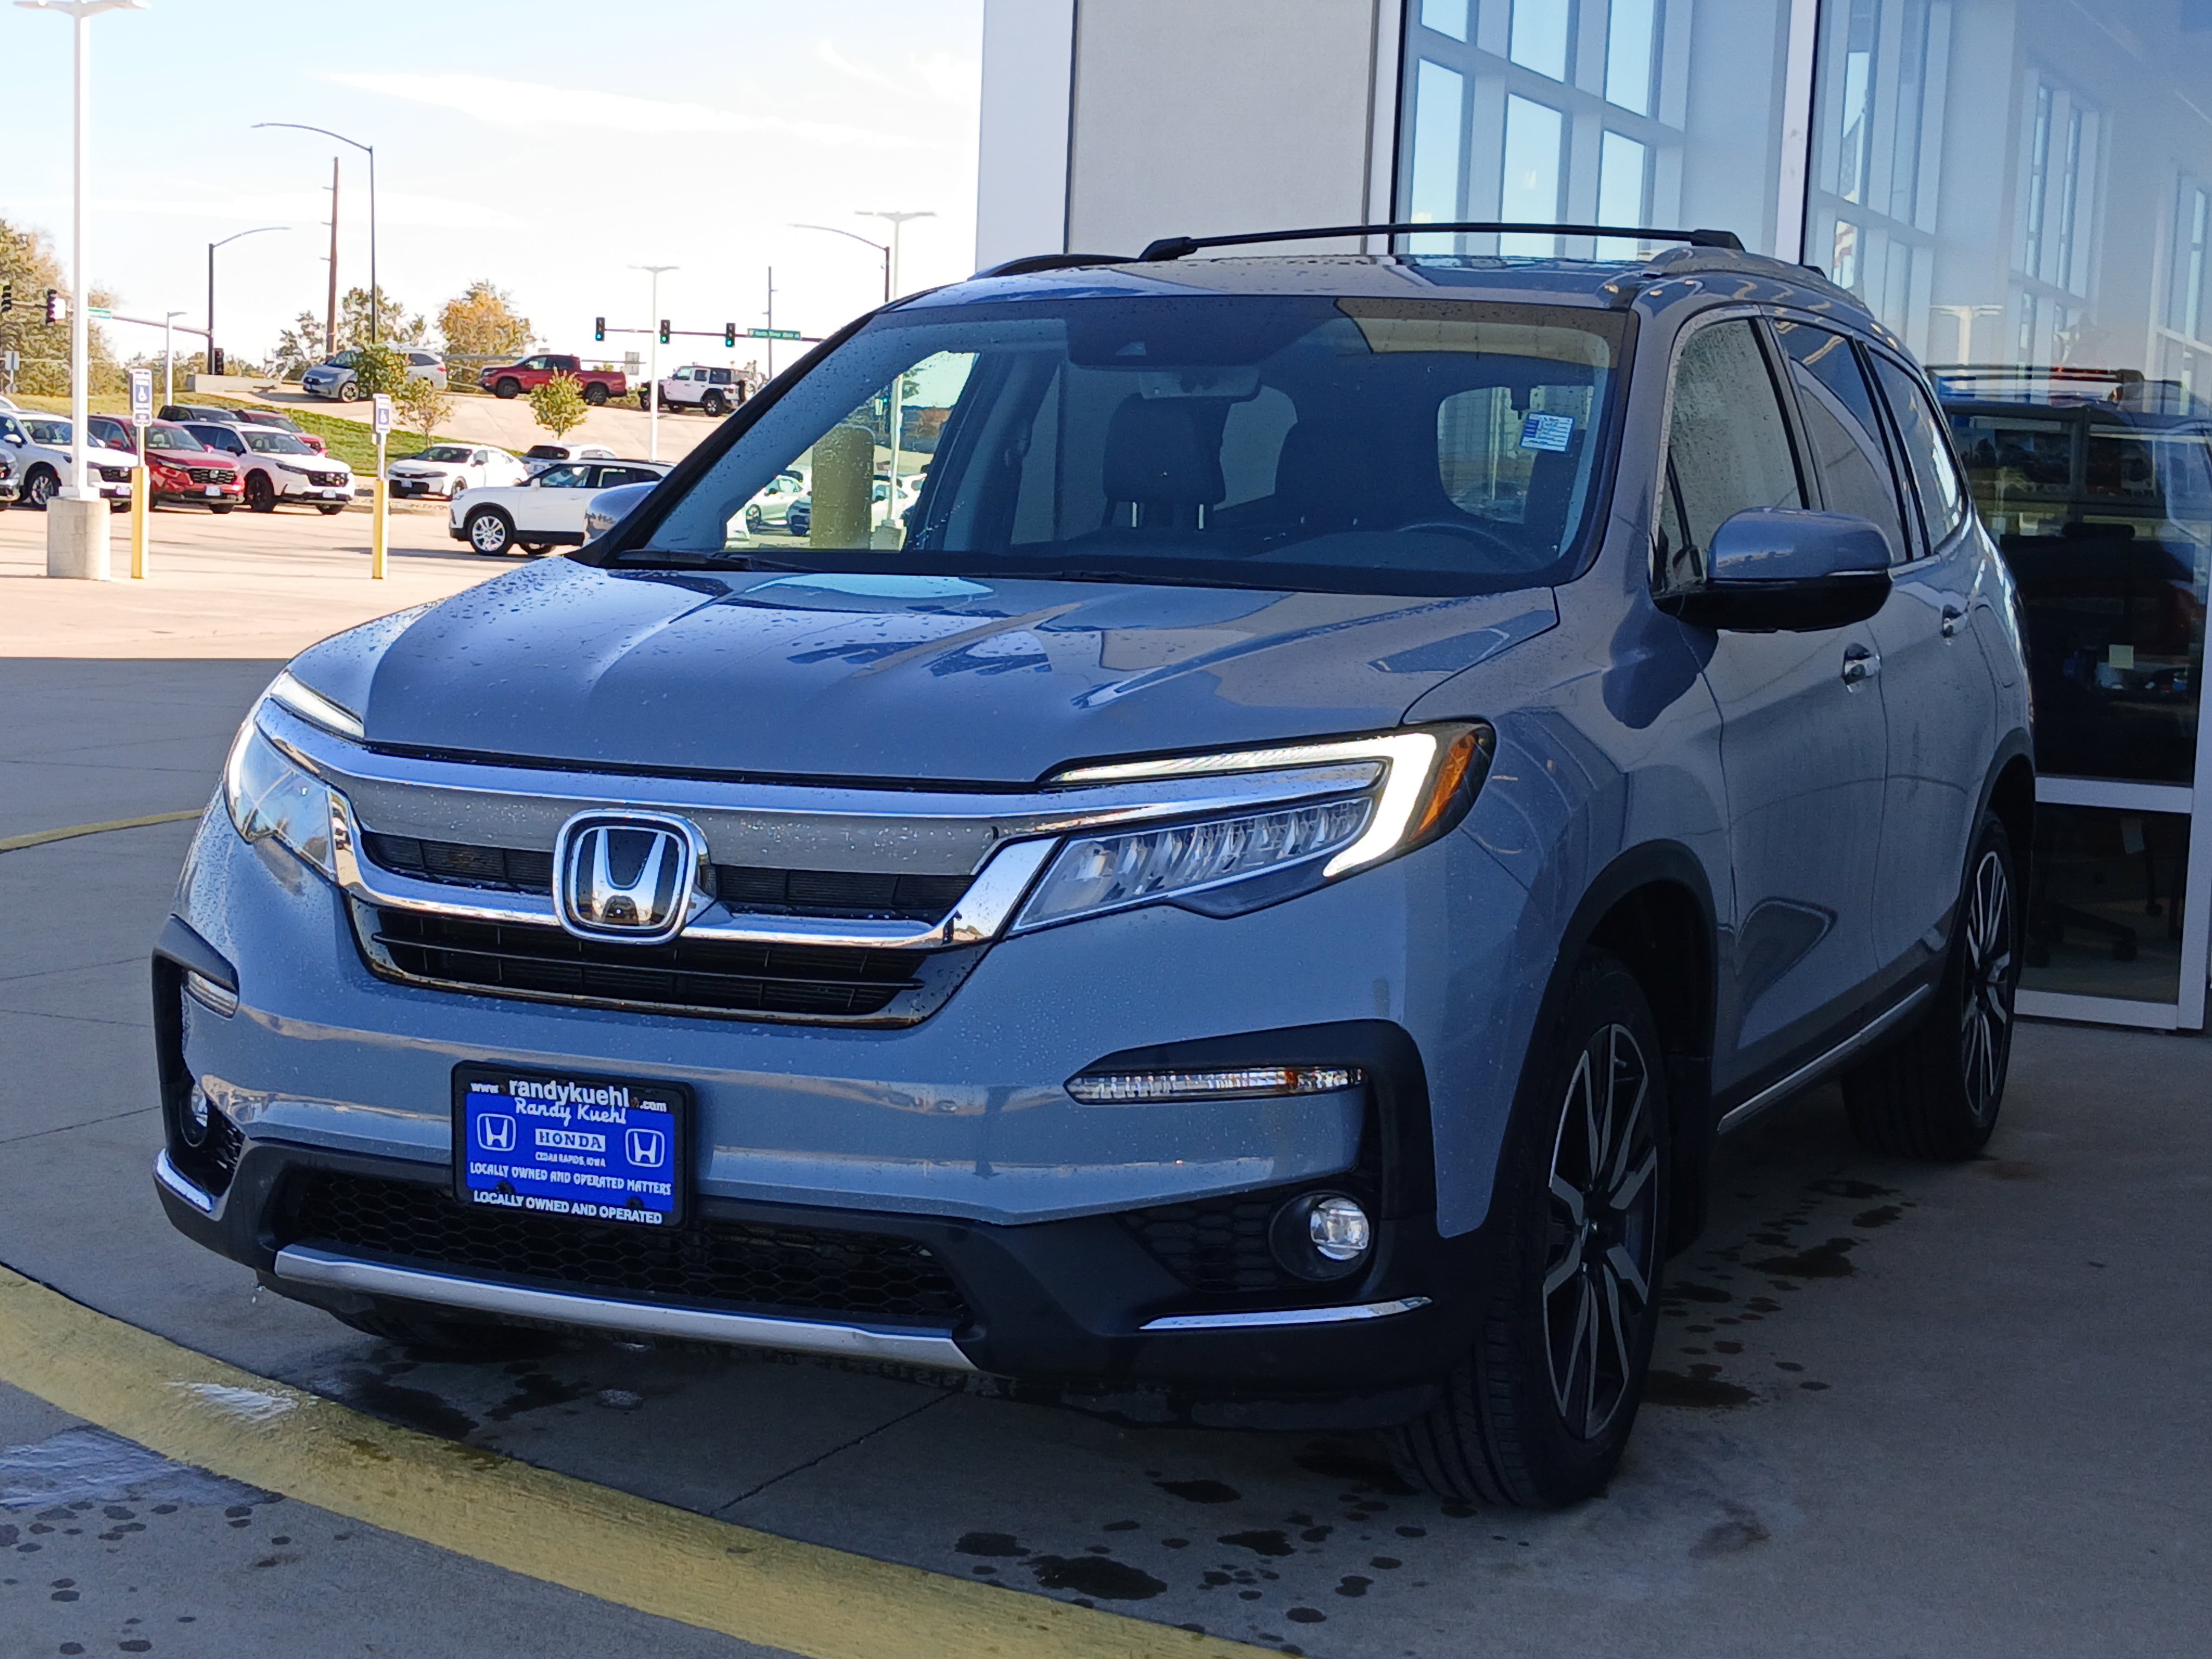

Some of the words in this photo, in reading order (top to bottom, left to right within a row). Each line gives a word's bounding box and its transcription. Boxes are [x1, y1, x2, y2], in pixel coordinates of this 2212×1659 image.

[509, 1079, 629, 1108] randykuehl
[515, 1097, 571, 1127] Randy
[577, 1104, 626, 1124] Kuehl
[539, 1131, 602, 1149] HONDA
[470, 1161, 509, 1178] LOCALLY
[511, 1167, 548, 1181] OWNED
[550, 1171, 571, 1184] AND
[573, 1173, 625, 1189] OPERATED
[627, 1179, 671, 1195] MATTERS
[473, 1189, 524, 1207] LOCALLY
[526, 1197, 569, 1213] OWNED
[571, 1203, 597, 1217] AND
[599, 1205, 663, 1224] OPERATED
